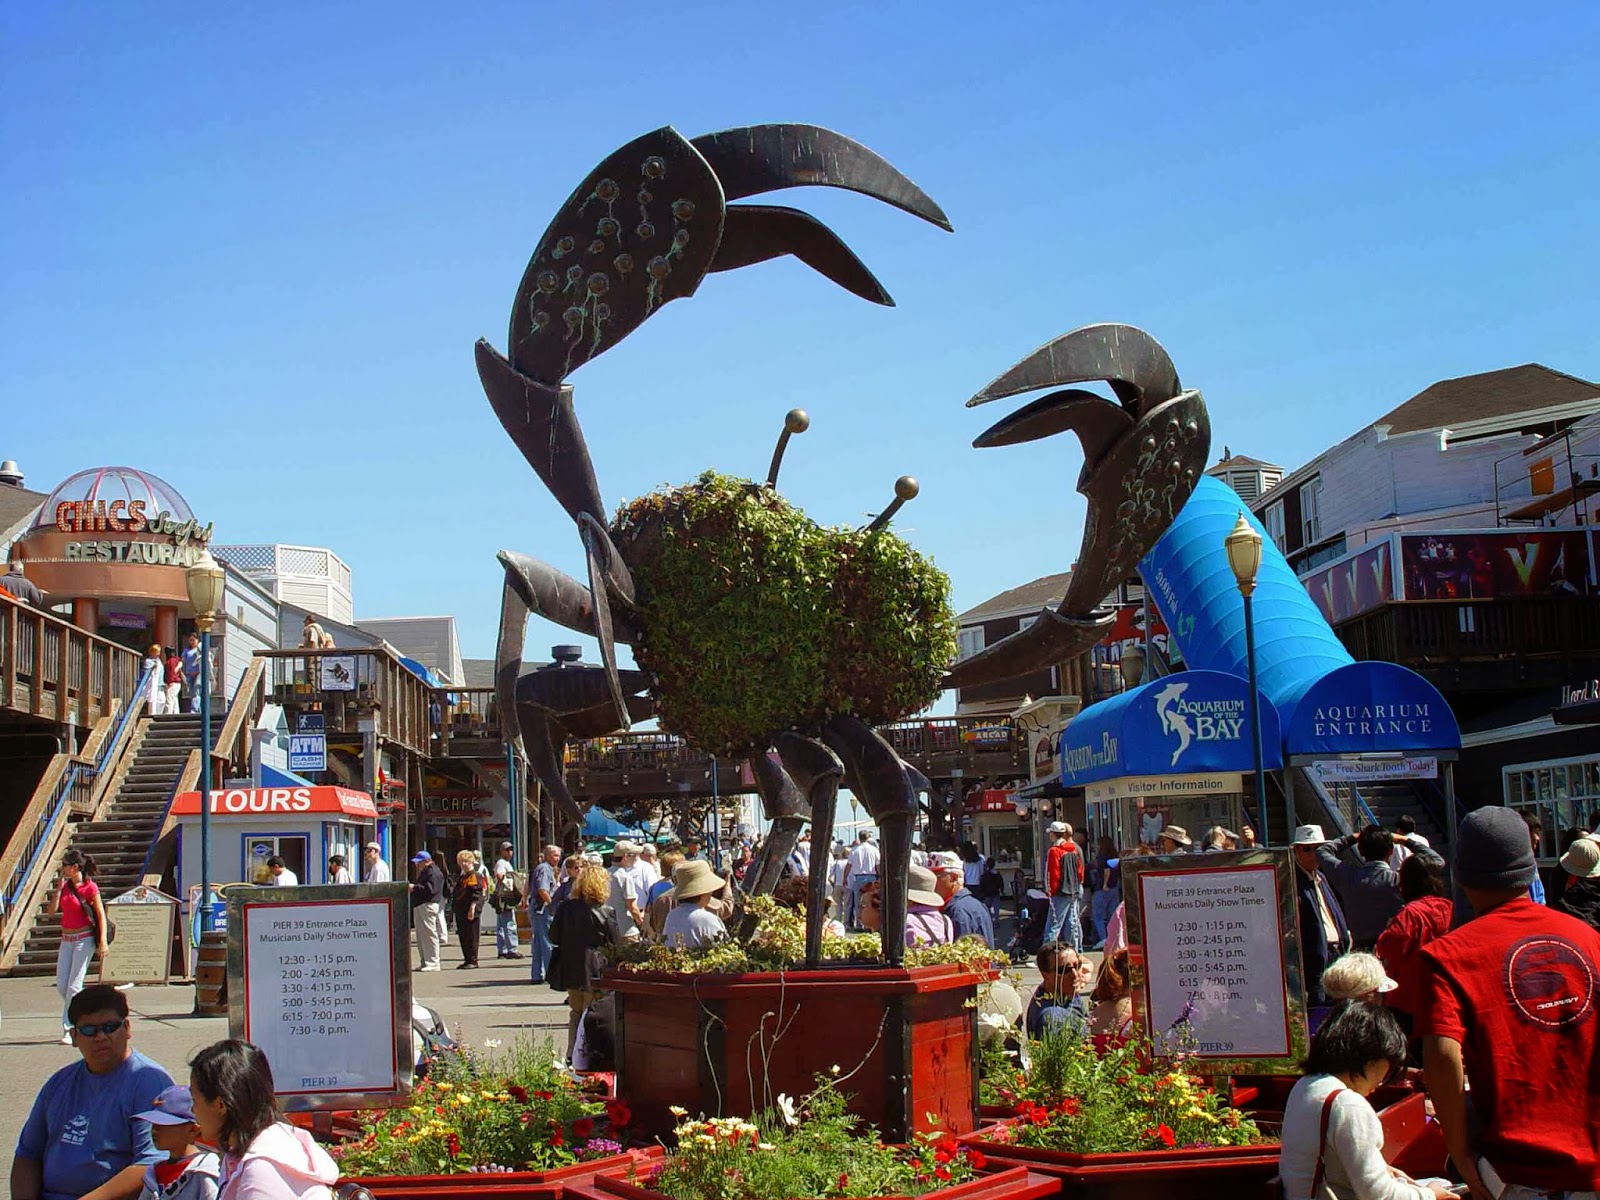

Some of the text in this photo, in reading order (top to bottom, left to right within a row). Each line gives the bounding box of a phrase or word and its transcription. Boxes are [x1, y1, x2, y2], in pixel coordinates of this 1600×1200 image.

[56, 499, 148, 532] CHICS
[65, 540, 201, 568] RESTAURAN
[1562, 679, 1600, 703] Hard R
[1177, 699, 1245, 716] AQUARIUM
[1314, 704, 1429, 720] AQUARIUM
[1196, 717, 1245, 740] BAY
[1315, 720, 1432, 736] ENTRANCE
[291, 738, 322, 753] ATM
[1103, 731, 1118, 764] BAY
[1336, 763, 1353, 773] Free
[1355, 762, 1380, 773] Shark
[1382, 761, 1407, 772] Tooth
[1408, 759, 1435, 771] Today!
[1128, 782, 1157, 793] Visitor
[1160, 779, 1224, 791] Information
[209, 789, 311, 812] TOURS
[1166, 884, 1256, 898] PIER 39 Entrance Plaza
[1155, 896, 1266, 911] Musicians Daily Show Times
[273, 917, 369, 930] PIER 39 Entrance Plaza
[1173, 922, 1198, 932] 12:30
[1206, 920, 1225, 930] 1:15
[1226, 920, 1247, 932] p.m.
[260, 929, 378, 943] Musicians Daily Show Times
[1176, 936, 1196, 946] 2:00
[1203, 934, 1223, 945] 2:45
[1224, 934, 1245, 946] p.m.
[279, 955, 305, 965] 12:30
[313, 954, 334, 964] 1:15
[336, 953, 358, 965] p.m.
[1177, 949, 1197, 959] 3:30
[1204, 948, 1224, 958] 4:15
[1225, 948, 1247, 960] p.m.
[281, 969, 303, 979] 2:00
[310, 968, 332, 978] 2:45
[333, 968, 355, 980] p.m.
[1178, 963, 1198, 973] 5:00
[1205, 962, 1225, 973] 5:45
[1226, 962, 1248, 974] p.m.
[281, 983, 303, 994] 3:30
[310, 982, 331, 993] 4:15
[333, 983, 356, 994] p.m.
[1179, 977, 1199, 987] 6:15
[1206, 977, 1226, 986] 7:00
[1227, 976, 1249, 987] p.m.
[282, 998, 303, 1008] 5:00
[310, 997, 332, 1007] 5:45
[333, 997, 356, 1008] p.m.
[1213, 991, 1220, 1000] 8
[1222, 991, 1243, 1001] p.m.
[282, 1012, 304, 1022] 6:15
[311, 1010, 333, 1021] 7:00
[334, 1011, 357, 1022] p.m.
[290, 1025, 311, 1036] 7:30
[319, 1024, 326, 1035] 8
[327, 1025, 350, 1036] p.m.
[1200, 1042, 1234, 1052] PIER 39
[301, 1076, 338, 1088] PIER 39
